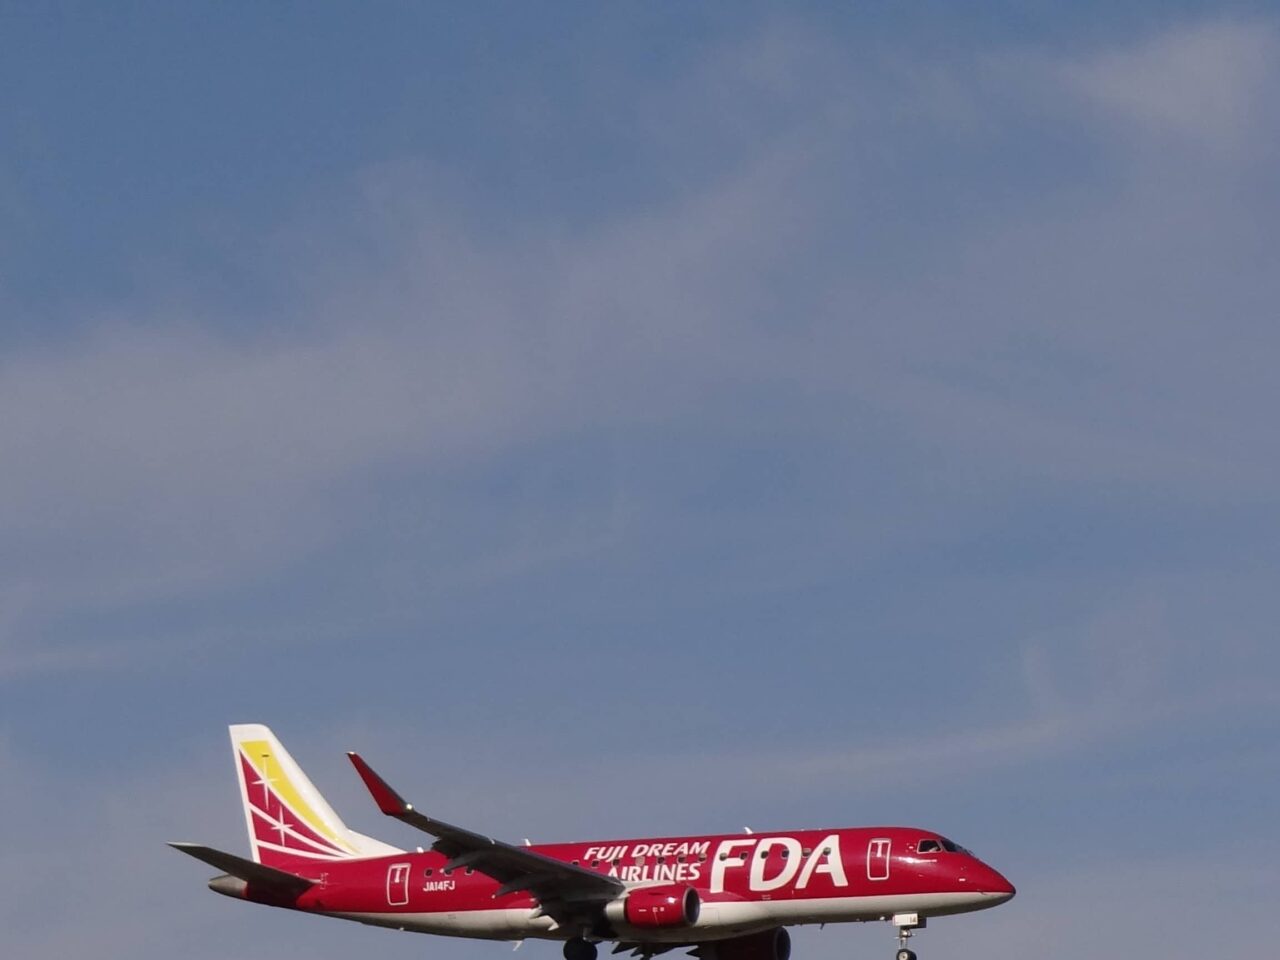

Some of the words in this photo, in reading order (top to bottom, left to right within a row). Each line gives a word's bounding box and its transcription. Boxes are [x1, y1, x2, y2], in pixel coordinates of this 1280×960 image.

[583, 845, 629, 862] FUJI
[631, 841, 711, 857] DREAM
[608, 863, 701, 882] AIRLINES
[710, 834, 849, 893] FDA
[422, 880, 456, 892] JA14FJ
